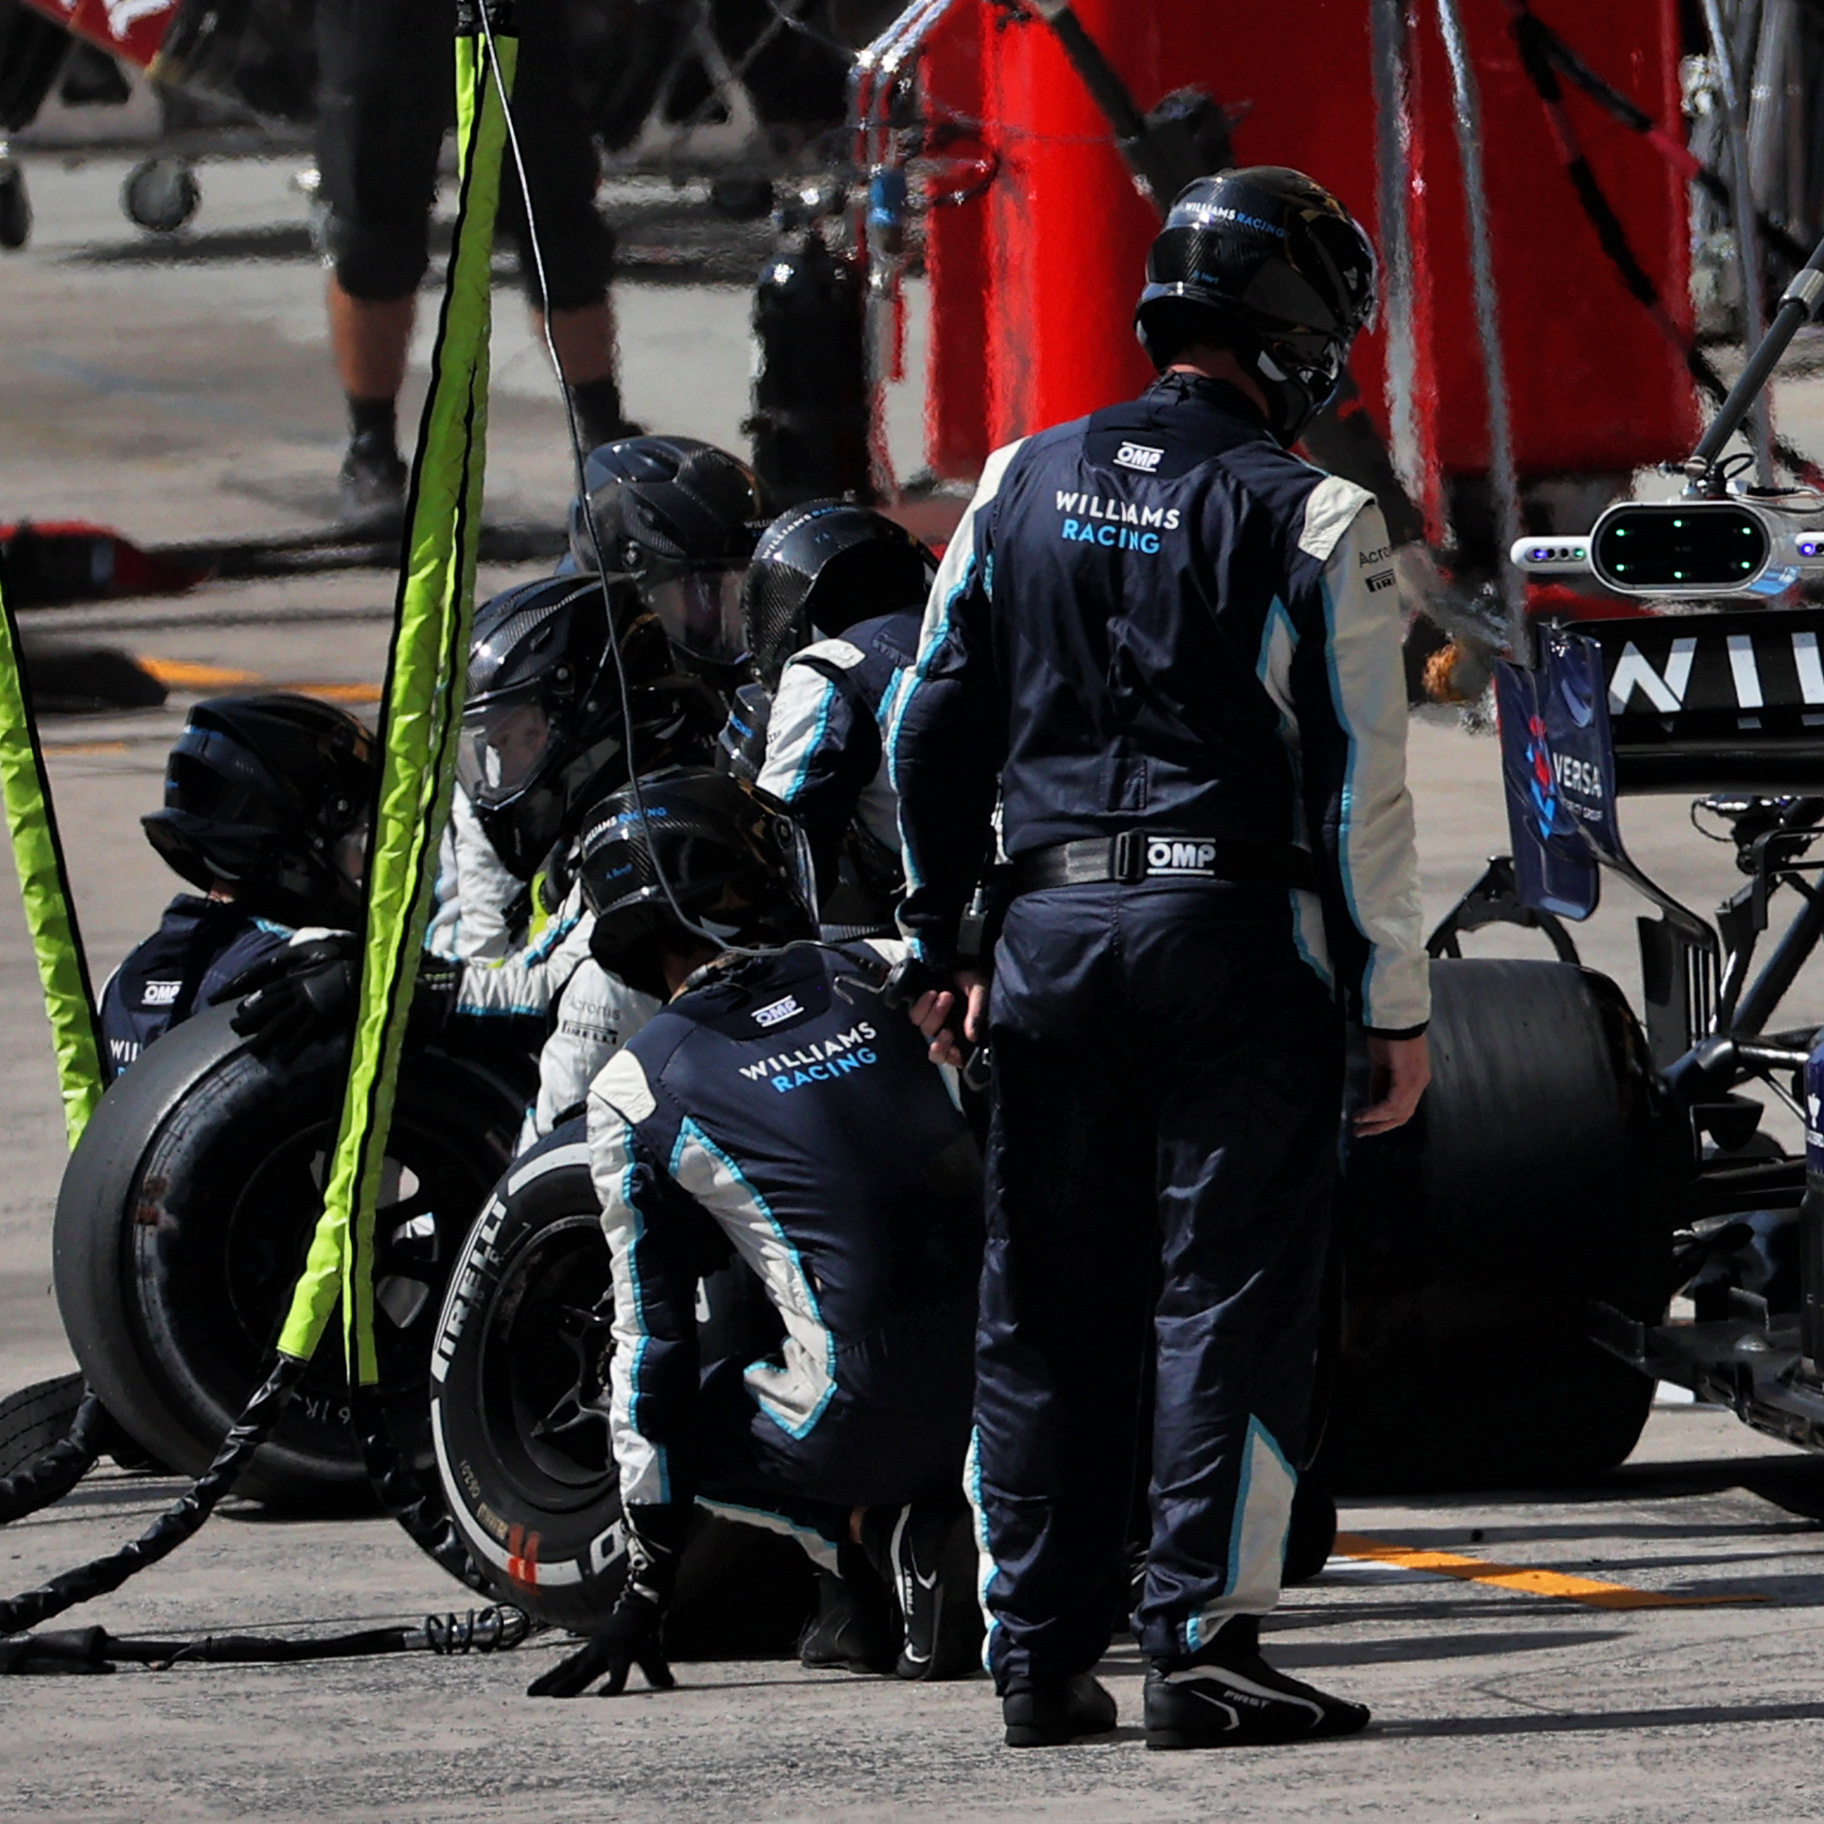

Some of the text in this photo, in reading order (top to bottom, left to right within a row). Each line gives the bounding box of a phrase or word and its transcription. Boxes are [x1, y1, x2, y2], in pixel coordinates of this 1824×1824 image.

[1184, 201, 1236, 222] WILLIAMS
[1115, 445, 1162, 469] OMP
[1055, 490, 1181, 530] WILLIAMS
[761, 513, 813, 560] WILLIAMS
[1062, 519, 1160, 554] RACING
[1146, 842, 1216, 868] OMP
[144, 984, 180, 1003] OMP
[755, 998, 799, 1025] OMP
[738, 1021, 878, 1082] WILLIAMS
[771, 1046, 878, 1094] RACING
[431, 1192, 509, 1384] PIRELLI
[1223, 1688, 1271, 1710] FIRST
